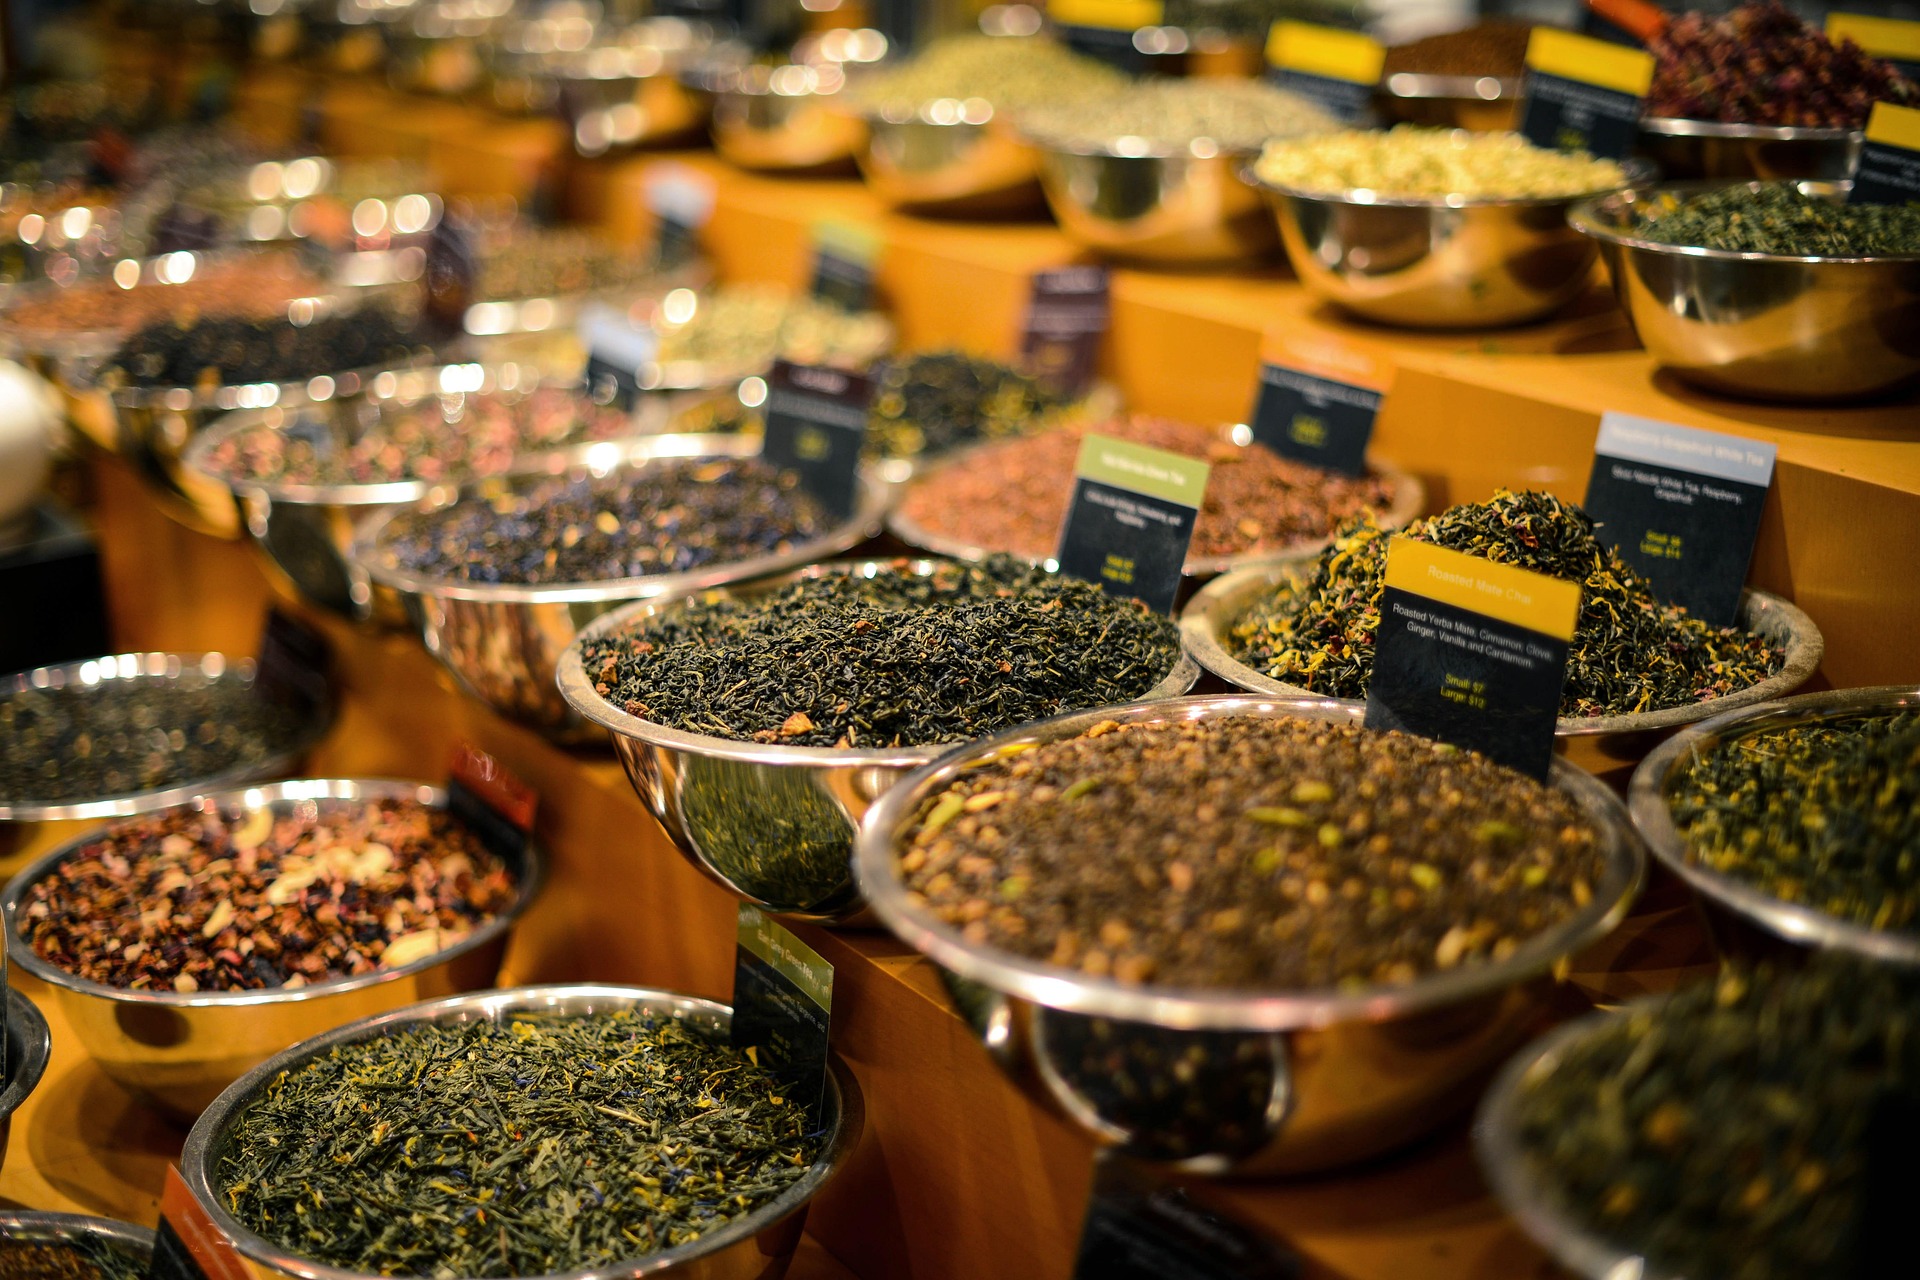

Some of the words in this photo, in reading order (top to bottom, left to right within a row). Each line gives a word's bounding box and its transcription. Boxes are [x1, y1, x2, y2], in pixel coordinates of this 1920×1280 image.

[1428, 565, 1473, 588] Roasted
[1476, 578, 1502, 597] Mate
[1506, 587, 1532, 605] Chai
[1393, 603, 1427, 622] Roasted
[1428, 613, 1452, 629] Yerba
[1526, 642, 1553, 662] Clove,
[1407, 621, 1437, 641] Ginger,
[1439, 631, 1466, 648] Vanilla
[1467, 641, 1483, 654] and
[785, 949, 802, 970] Green
[803, 962, 813, 980] Tea
